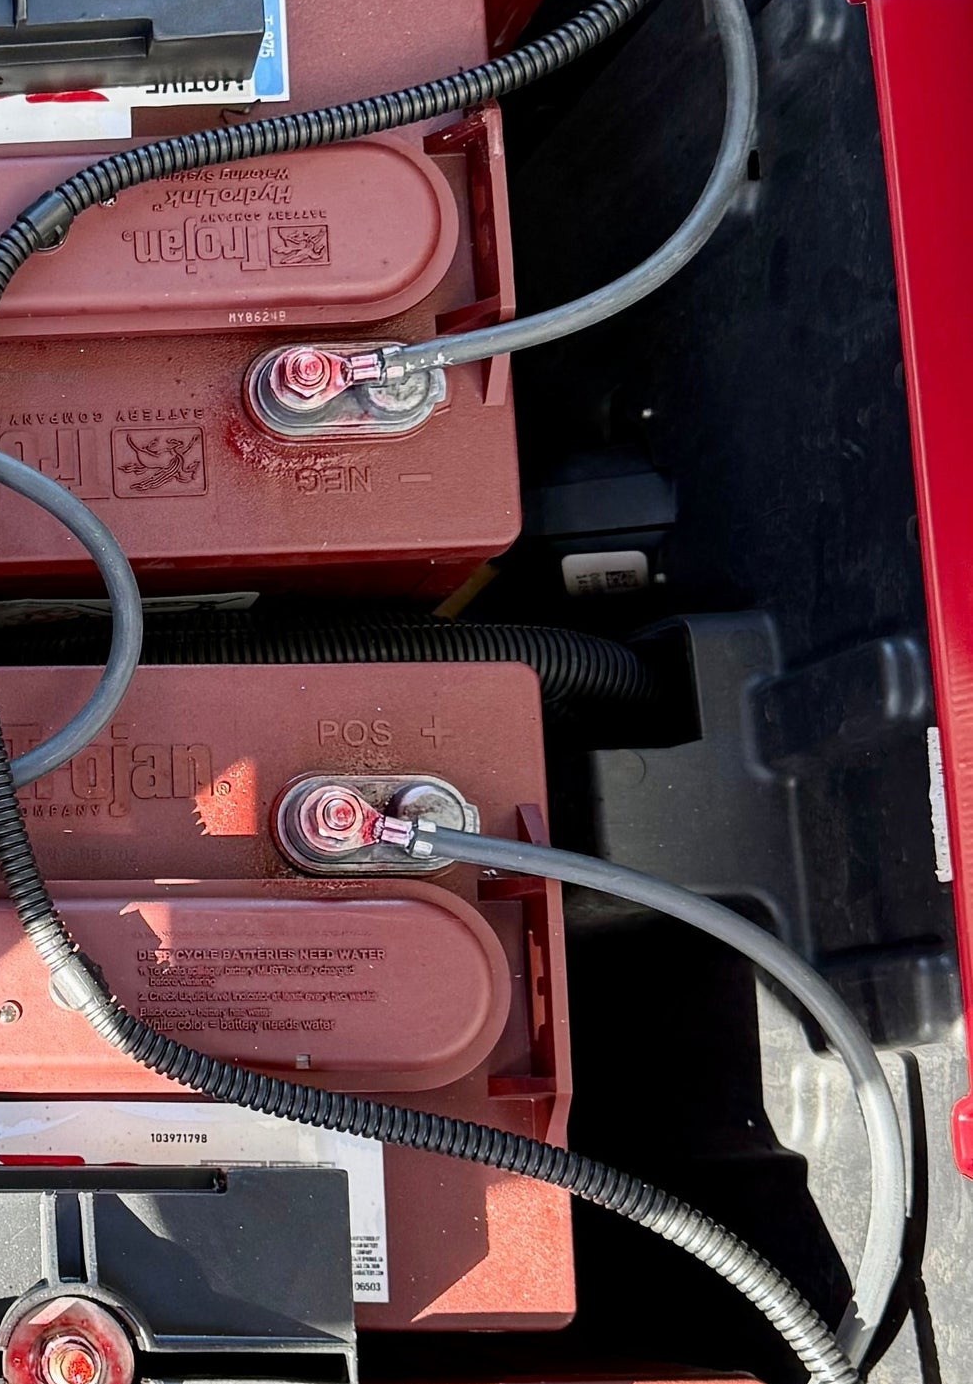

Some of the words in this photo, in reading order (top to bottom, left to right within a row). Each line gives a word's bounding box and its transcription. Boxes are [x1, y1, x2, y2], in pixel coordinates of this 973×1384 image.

[219, 167, 289, 181] Watering
[200, 212, 260, 223] COMPANY
[268, 209, 327, 224] BATTERY
[8, 410, 102, 426] COMPANY
[114, 406, 203, 424] BATTERY
[296, 465, 372, 495] NEG
[317, 720, 393, 747] POS
[176, 949, 218, 961] CYCLE
[223, 949, 295, 961] BATTERIES
[299, 949, 334, 961] NEED
[337, 949, 386, 961] WATER
[177, 1019, 206, 1031] color
[220, 1019, 260, 1033] battery
[262, 1019, 299, 1031] needs
[302, 1020, 335, 1031] water
[150, 1133, 208, 1143] 103971798
